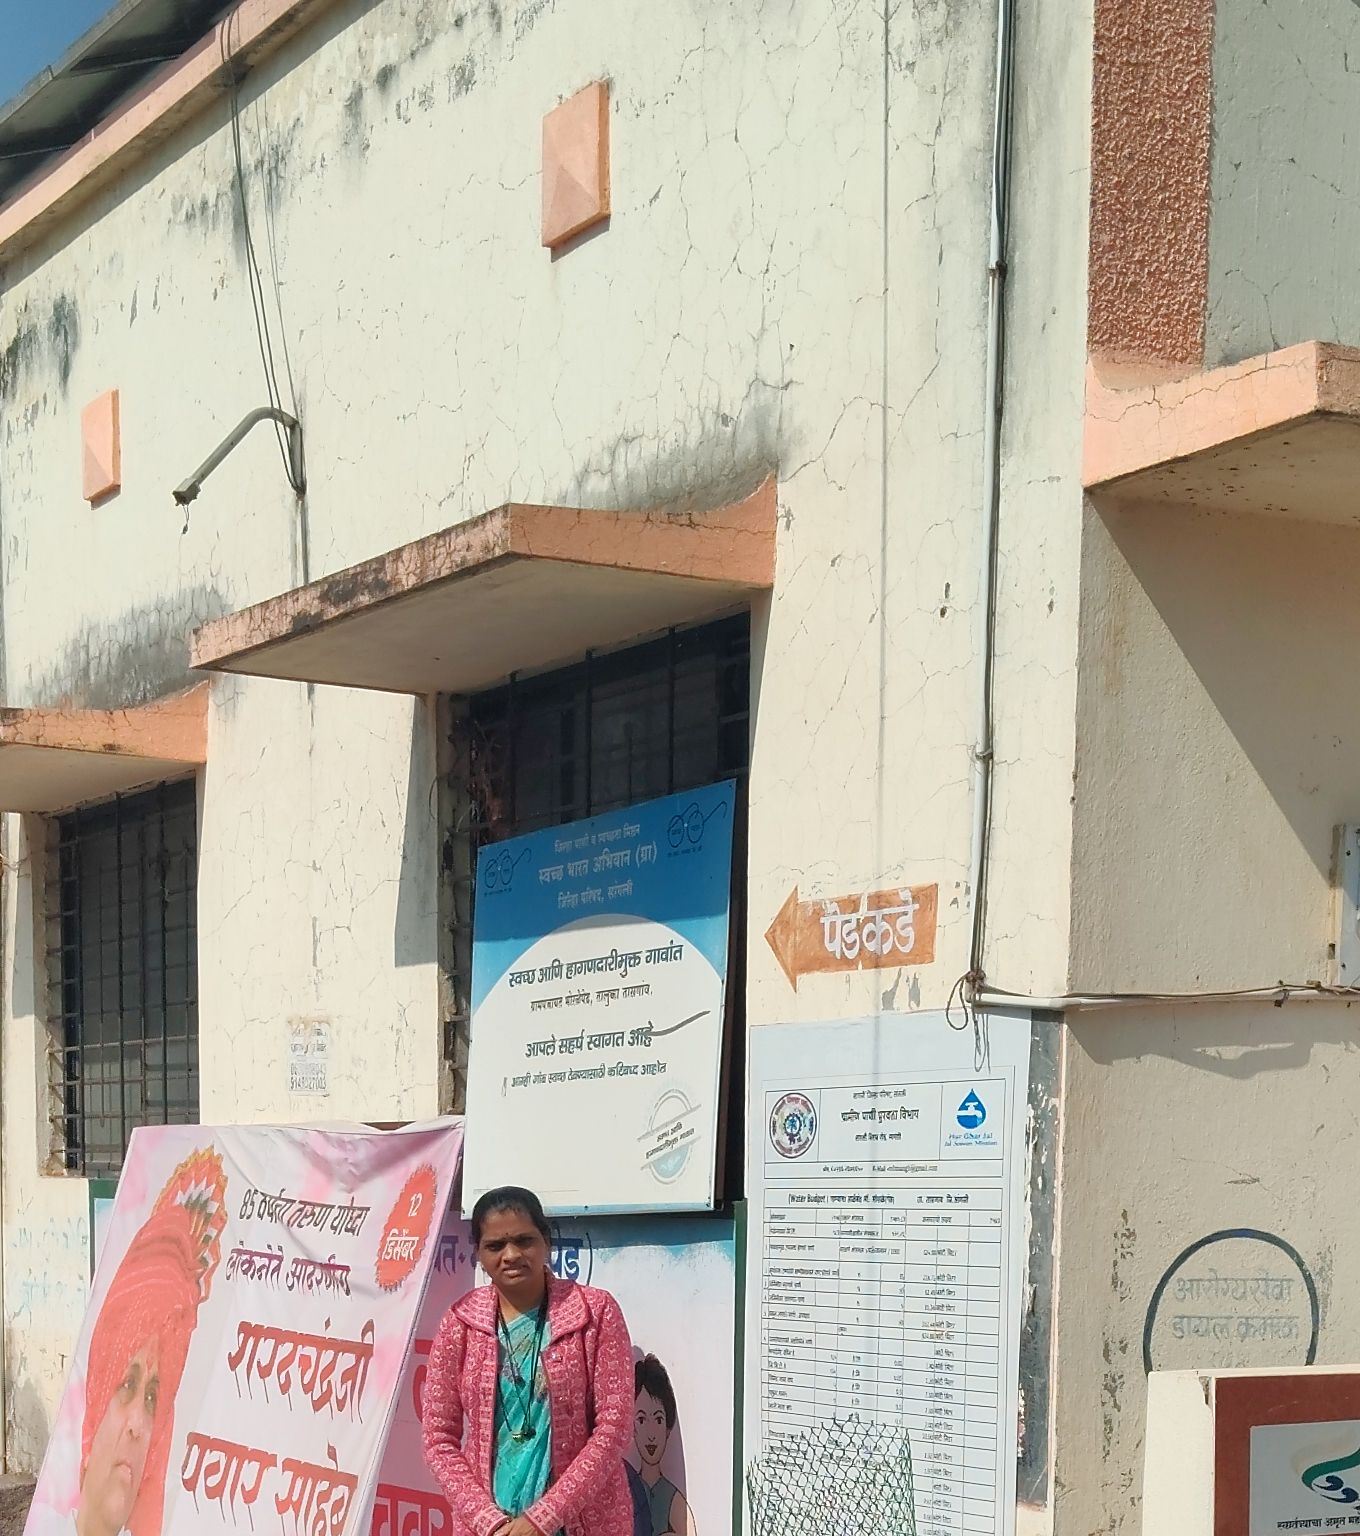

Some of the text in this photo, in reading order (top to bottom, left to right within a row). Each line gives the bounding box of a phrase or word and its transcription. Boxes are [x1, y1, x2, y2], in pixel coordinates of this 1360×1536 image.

[539, 865, 564, 885] स्वच्छ
[567, 859, 589, 878] भारत
[592, 848, 631, 873] अभियान
[635, 841, 657, 866] (ग्रा)
[508, 940, 684, 987] स्वच्छ आणि हागणदारीमुक्त गावांत
[525, 1021, 654, 1058] आपले सहर्ष स्वागत आहे
[239, 1188, 259, 1220] 85
[286, 1200, 336, 1232] तरुण
[408, 1192, 424, 1218] 12
[381, 1228, 419, 1261] डिसेंबर
[225, 1241, 352, 1296] लोकनेते आदरणीय
[181, 1431, 278, 1516] पवार
[1324, 1515, 1346, 1529] अमृत
